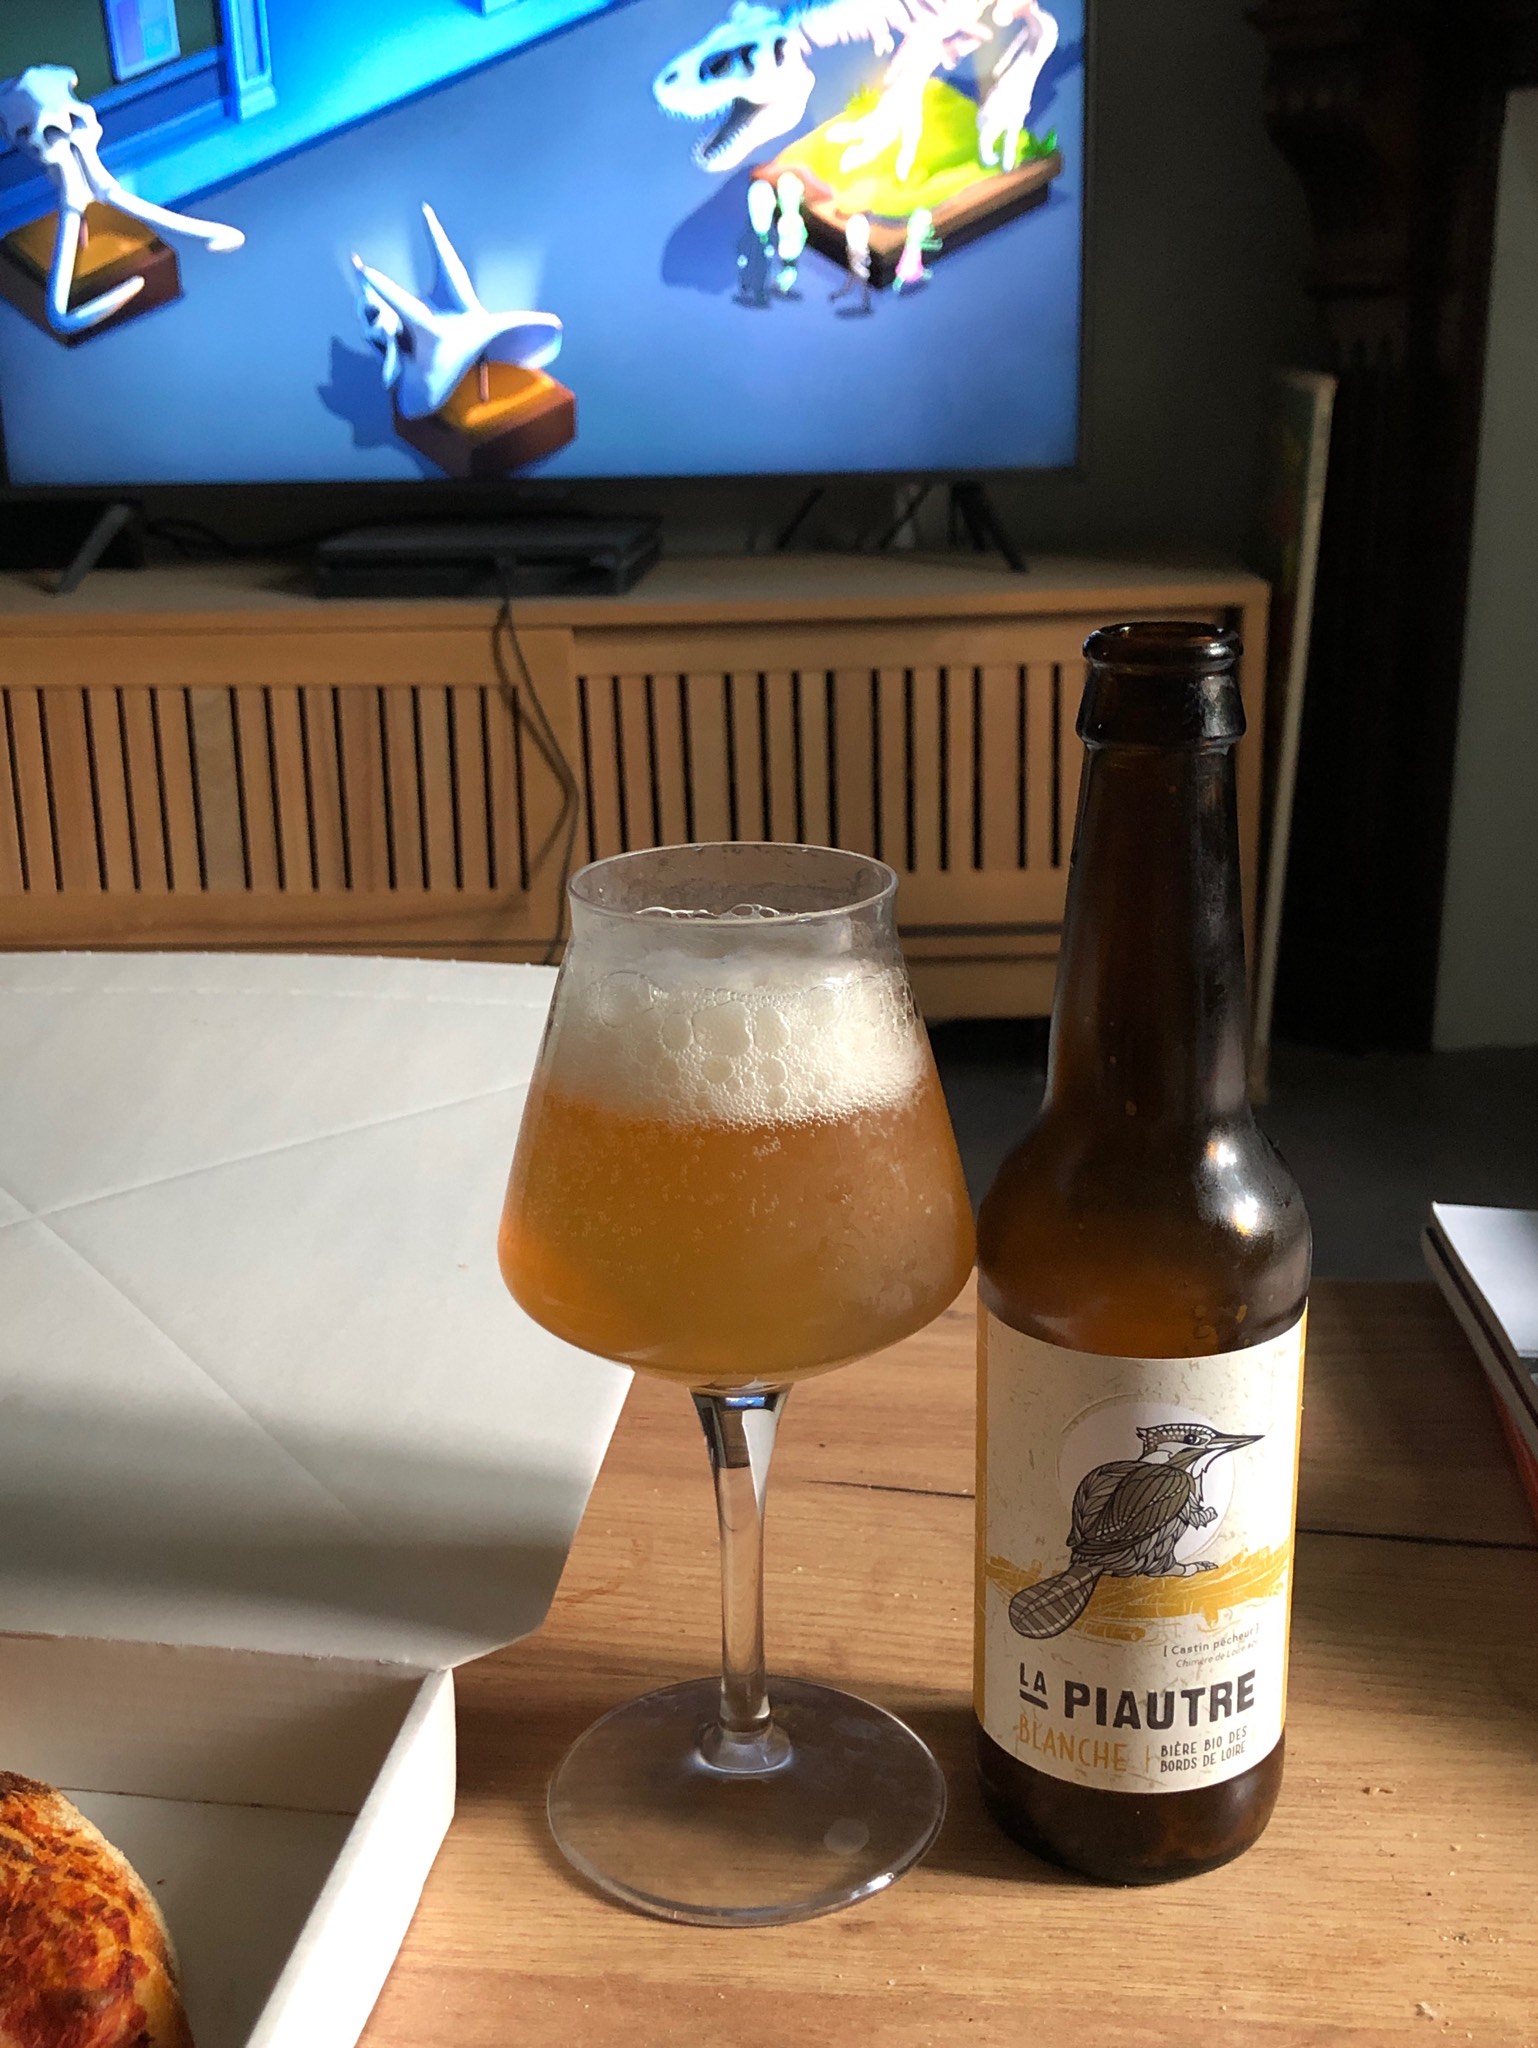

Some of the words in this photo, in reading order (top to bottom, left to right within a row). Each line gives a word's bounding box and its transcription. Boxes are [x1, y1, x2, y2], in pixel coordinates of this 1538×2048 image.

[1171, 1642, 1209, 1655] Castin
[1215, 1651, 1225, 1661] de
[1020, 1662, 1047, 1695] LA
[1064, 1669, 1256, 1730] PIAUTRE
[1019, 1713, 1128, 1772] BLANCHE
[1160, 1757, 1198, 1773] BORDS
[1202, 1752, 1217, 1767] DE
[1221, 1740, 1246, 1762] LOIRE
[1161, 1741, 1198, 1758] BIÈRE
[1204, 1735, 1223, 1752] BIO
[1229, 1725, 1248, 1744] DES
